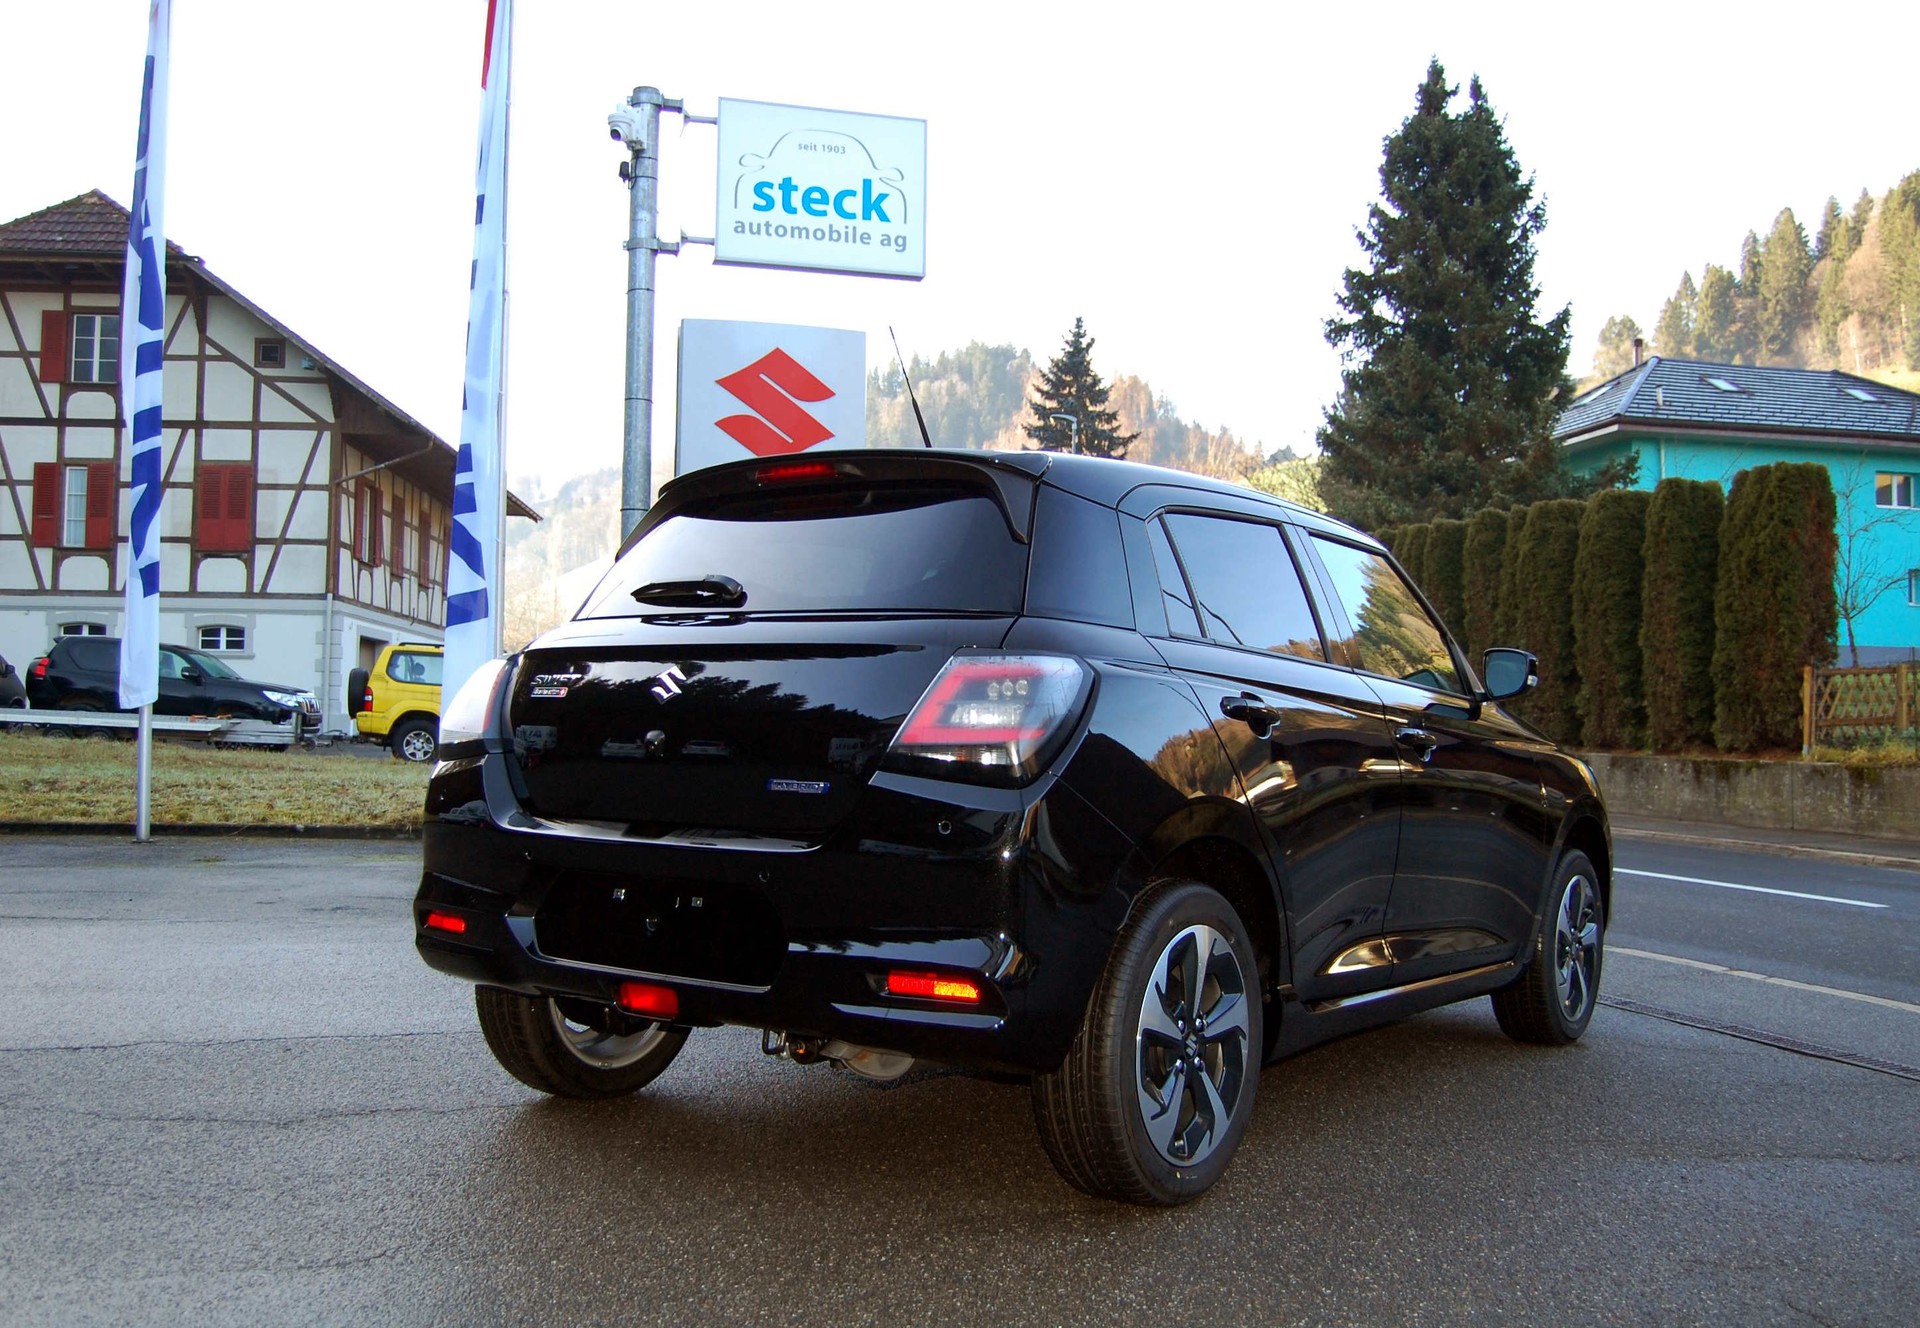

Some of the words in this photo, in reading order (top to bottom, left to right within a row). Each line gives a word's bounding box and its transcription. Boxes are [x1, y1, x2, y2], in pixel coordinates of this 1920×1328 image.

[798, 142, 817, 152] seit
[822, 144, 846, 154] 1903
[752, 176, 891, 223] steck
[733, 220, 872, 245] automobile
[879, 234, 908, 253] ag
